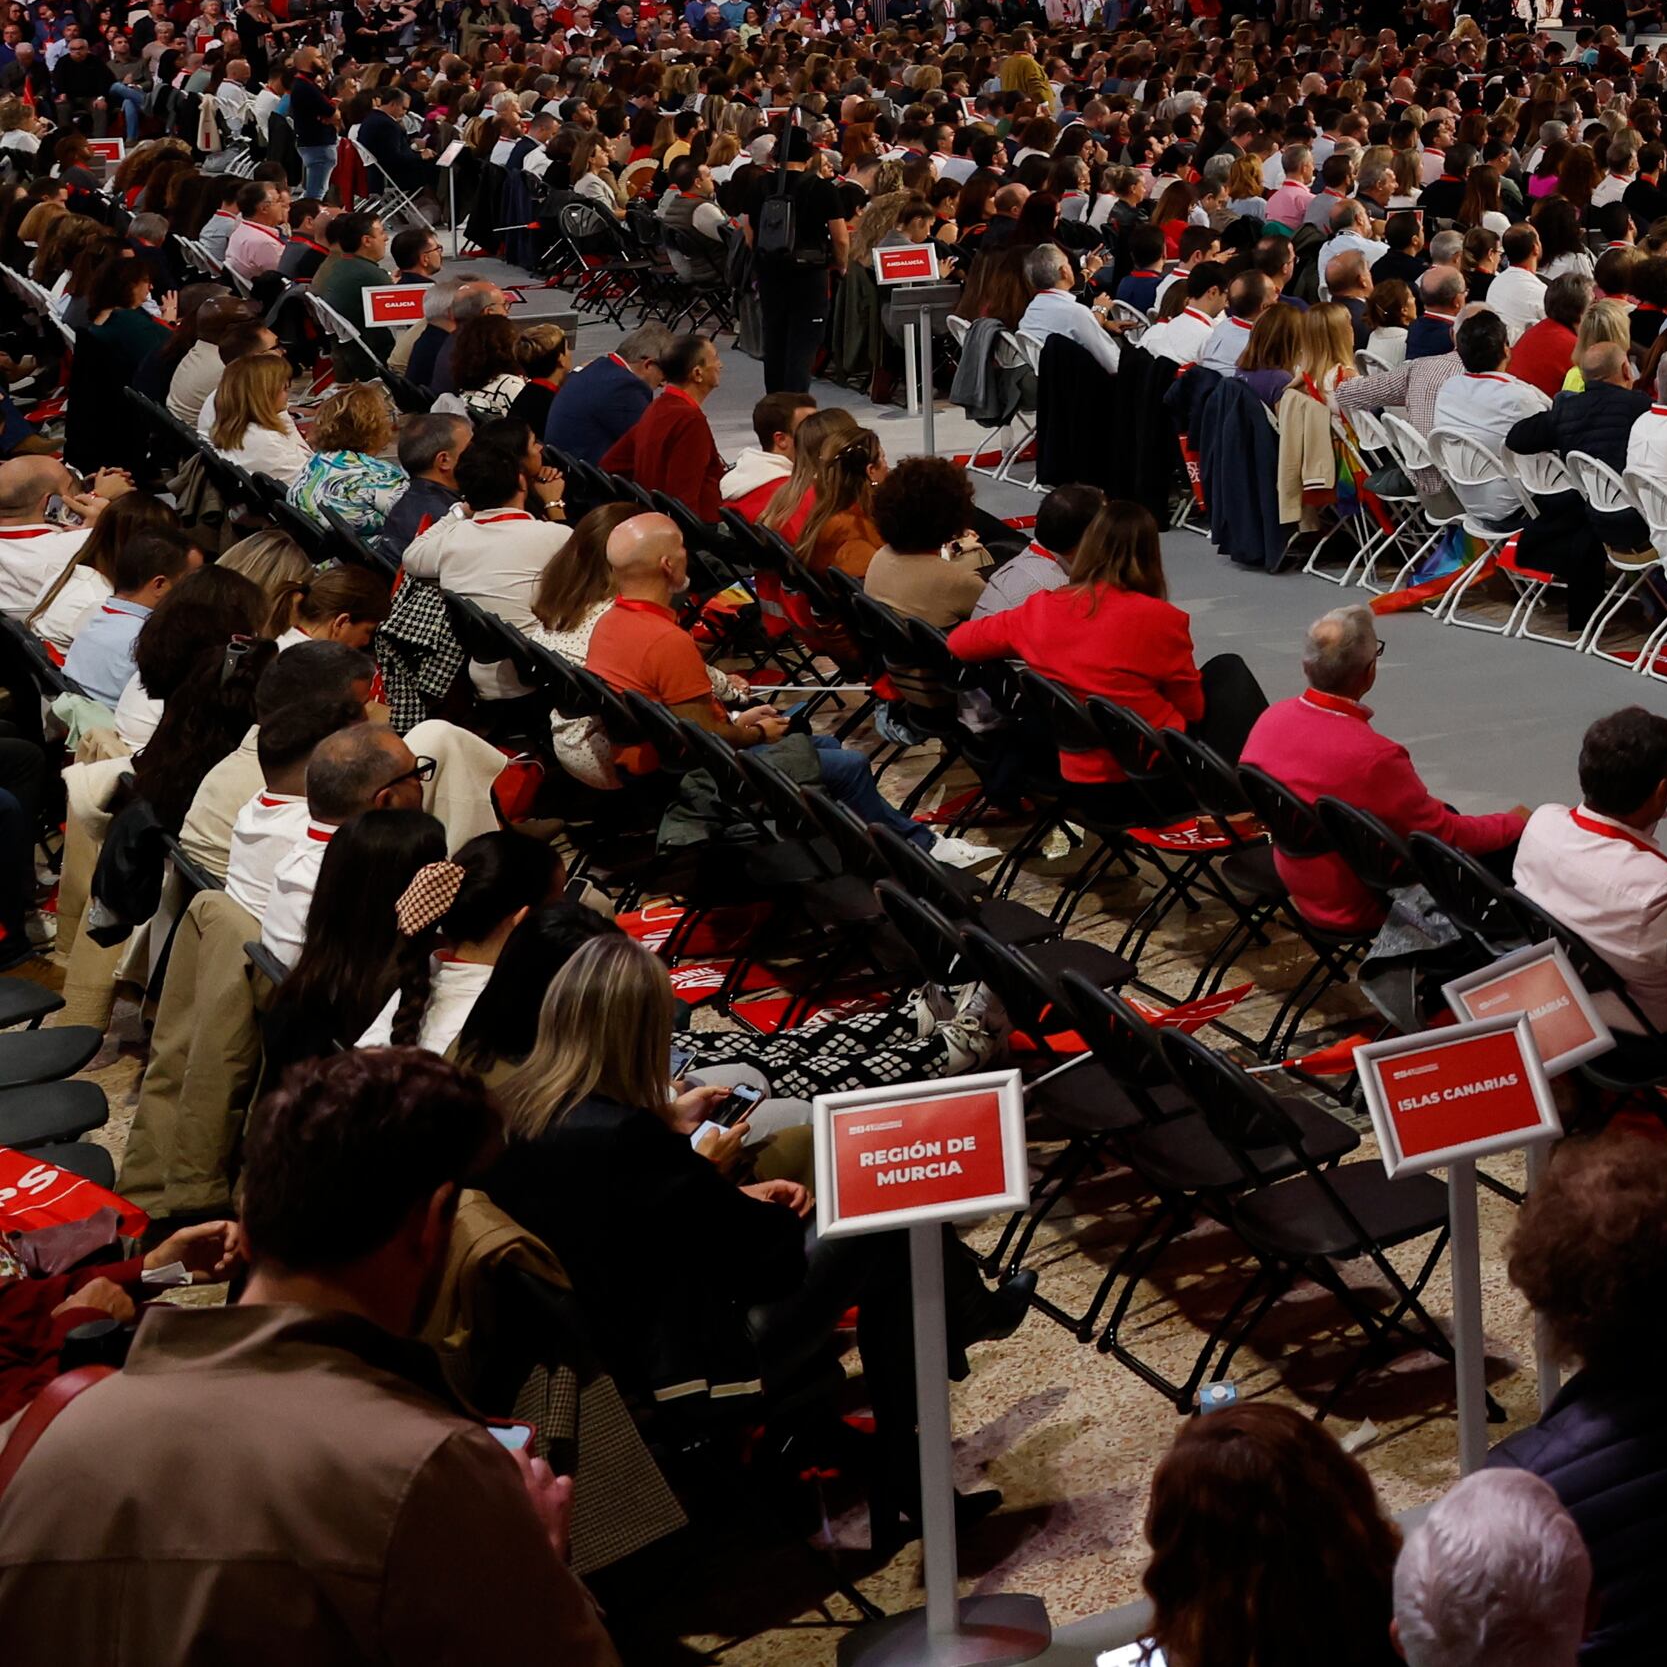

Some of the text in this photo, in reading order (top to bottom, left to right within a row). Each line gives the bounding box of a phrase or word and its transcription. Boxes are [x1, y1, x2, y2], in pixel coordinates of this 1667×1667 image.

[1528, 995, 1570, 1022] ANARIAS
[1397, 1073, 1519, 1112] ISLAS CANARIAS
[859, 1136, 976, 1168] REGIÓN DE
[876, 1160, 963, 1187] MURCIA
